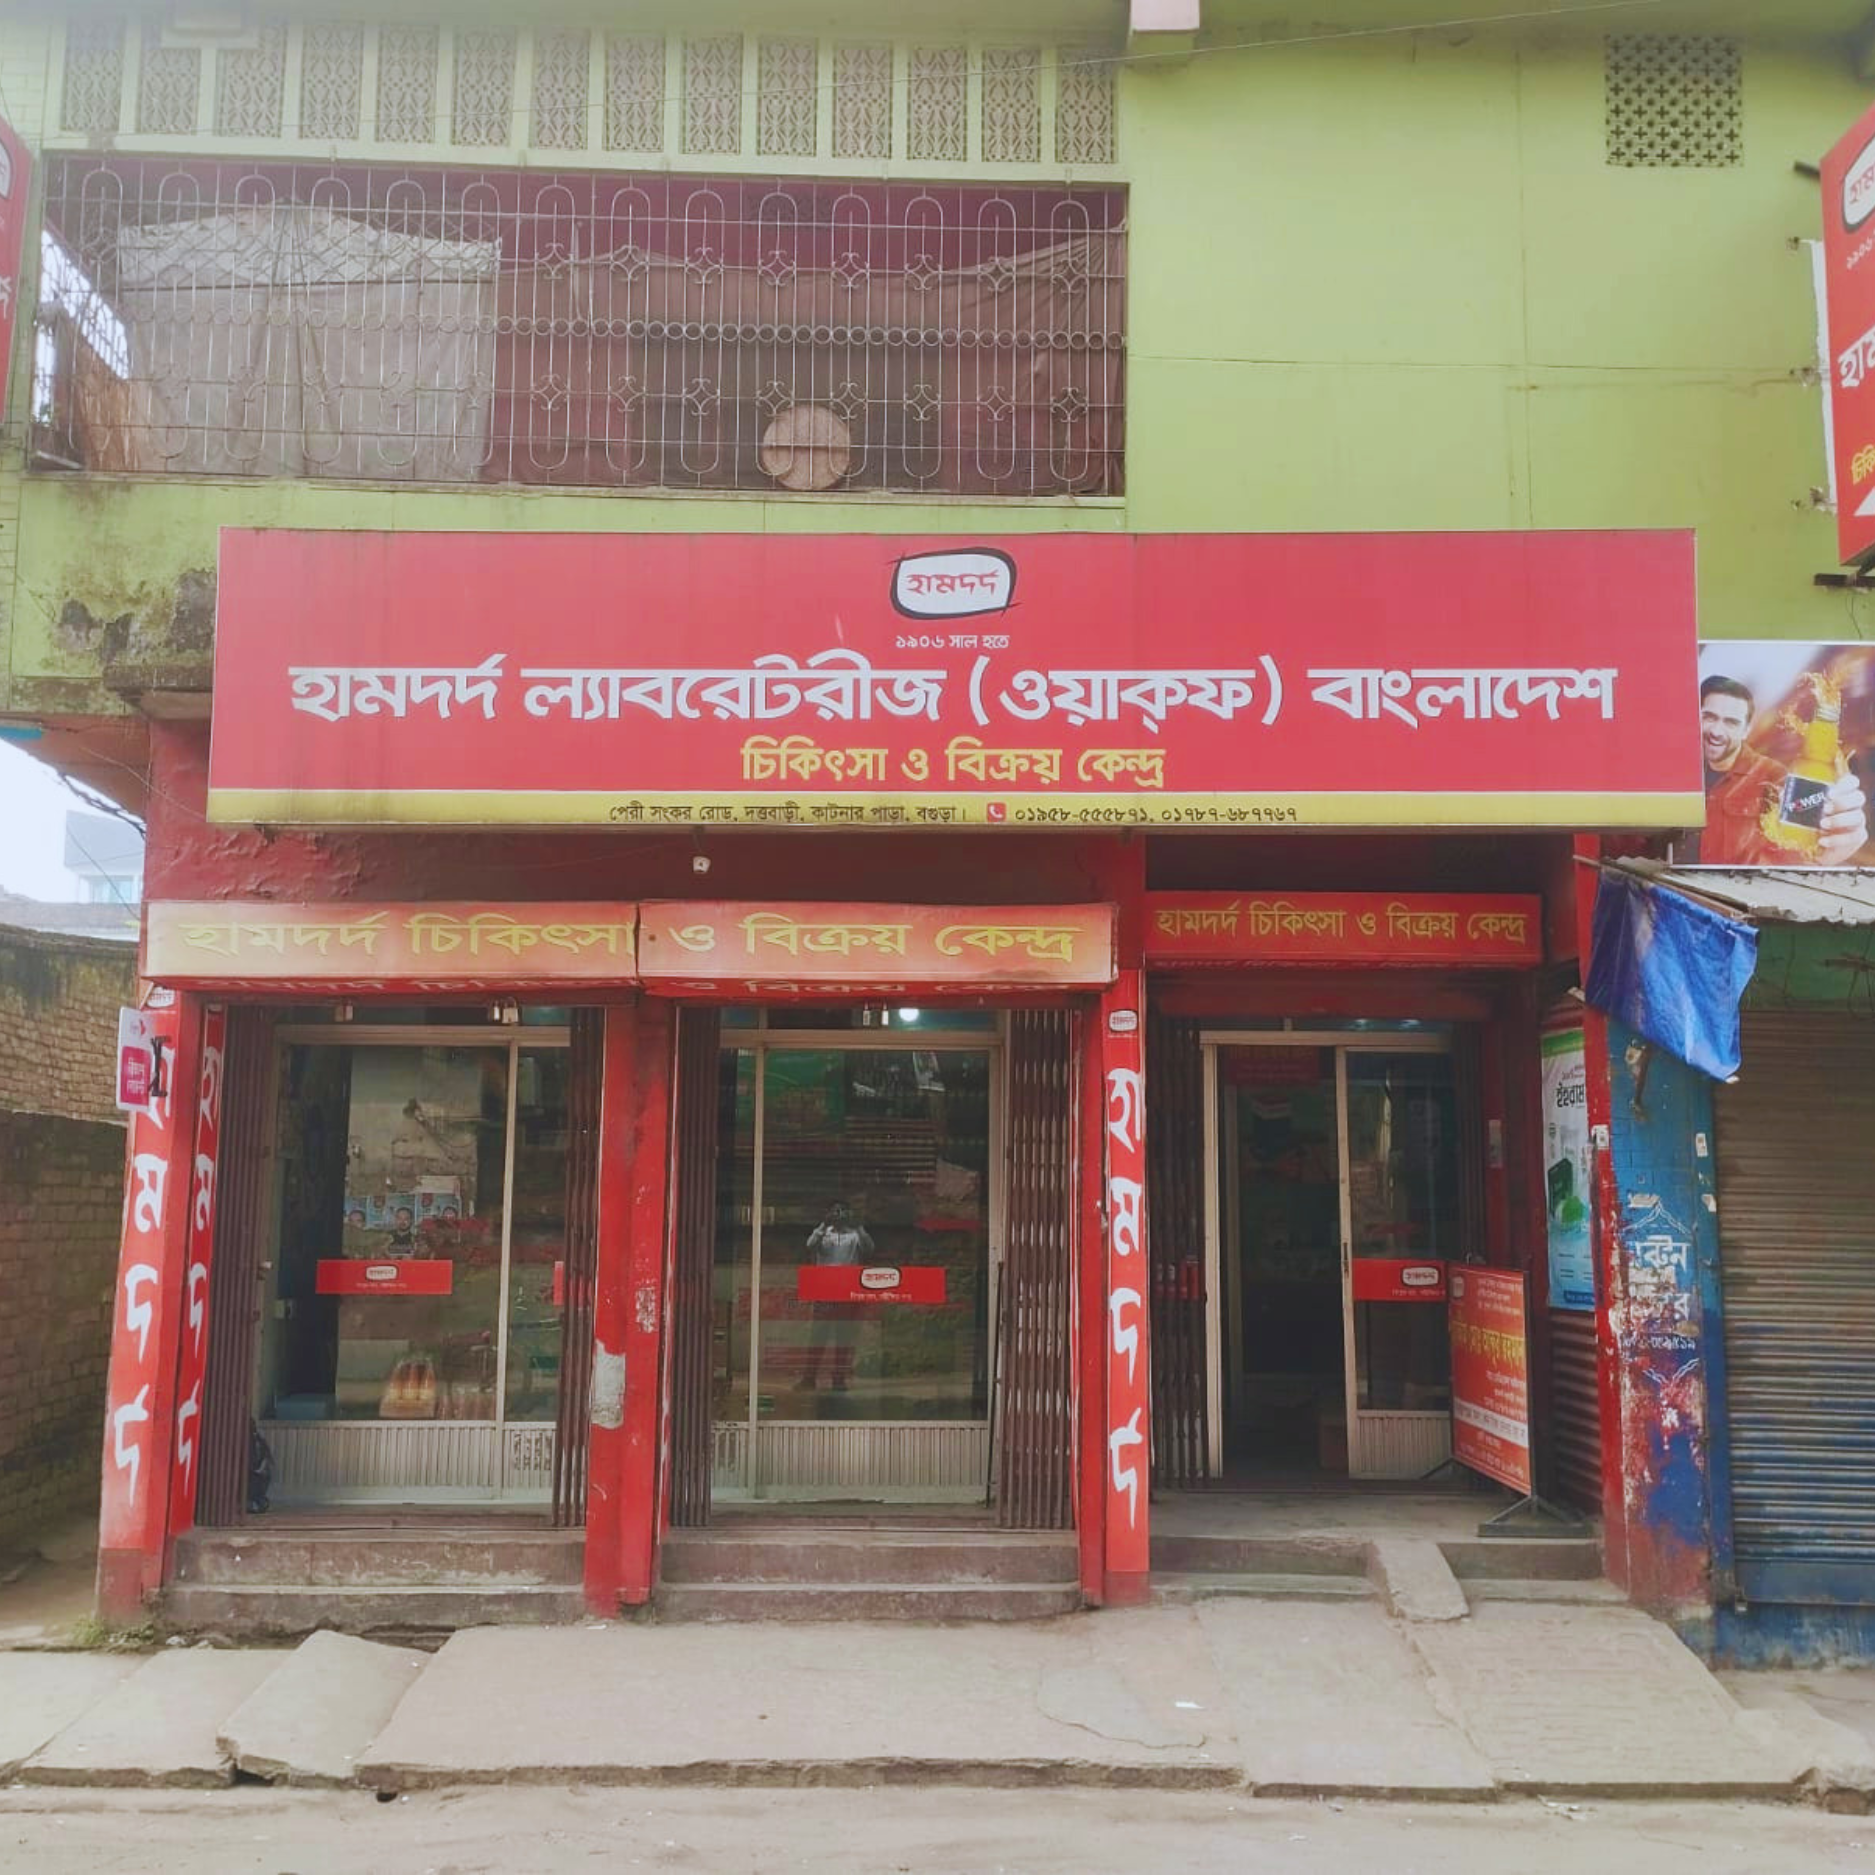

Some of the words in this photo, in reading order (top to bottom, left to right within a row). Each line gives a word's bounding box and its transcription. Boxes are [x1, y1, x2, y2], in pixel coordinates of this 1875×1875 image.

[906, 569, 1000, 596] হামদর্দ
[896, 635, 944, 649] ১৯০৬
[948, 635, 978, 649] সাল
[981, 635, 1010, 649] হতে
[289, 653, 507, 722] হামদর্দ
[520, 649, 947, 722] ল্যাবরেটরীজ
[1307, 667, 1618, 729] বাংলাদেশ
[741, 736, 888, 782] চিকিৎসা
[901, 748, 929, 781] ও
[946, 736, 1062, 785] বিক্রয়
[1077, 748, 1166, 789] কেন্দ্র
[609, 800, 645, 821] পেরী
[649, 806, 694, 822] সংকর
[809, 802, 864, 822] কাটনার
[1161, 807, 1297, 822] ০১৭৮৭-৬৮৭৭৬৭
[179, 910, 390, 958] হামদর্দ
[403, 912, 634, 957] চিকিৎসা
[669, 923, 717, 953] ও
[739, 911, 913, 957] বিক্রয়
[934, 924, 1085, 963] কেন্দ্র
[1156, 898, 1241, 937] হামদর্দ
[1249, 901, 1347, 938] চিকিৎসা
[1356, 913, 1377, 936] ও
[1385, 902, 1459, 940] বিক্রয়
[1466, 911, 1529, 944] কেন্দ্র
